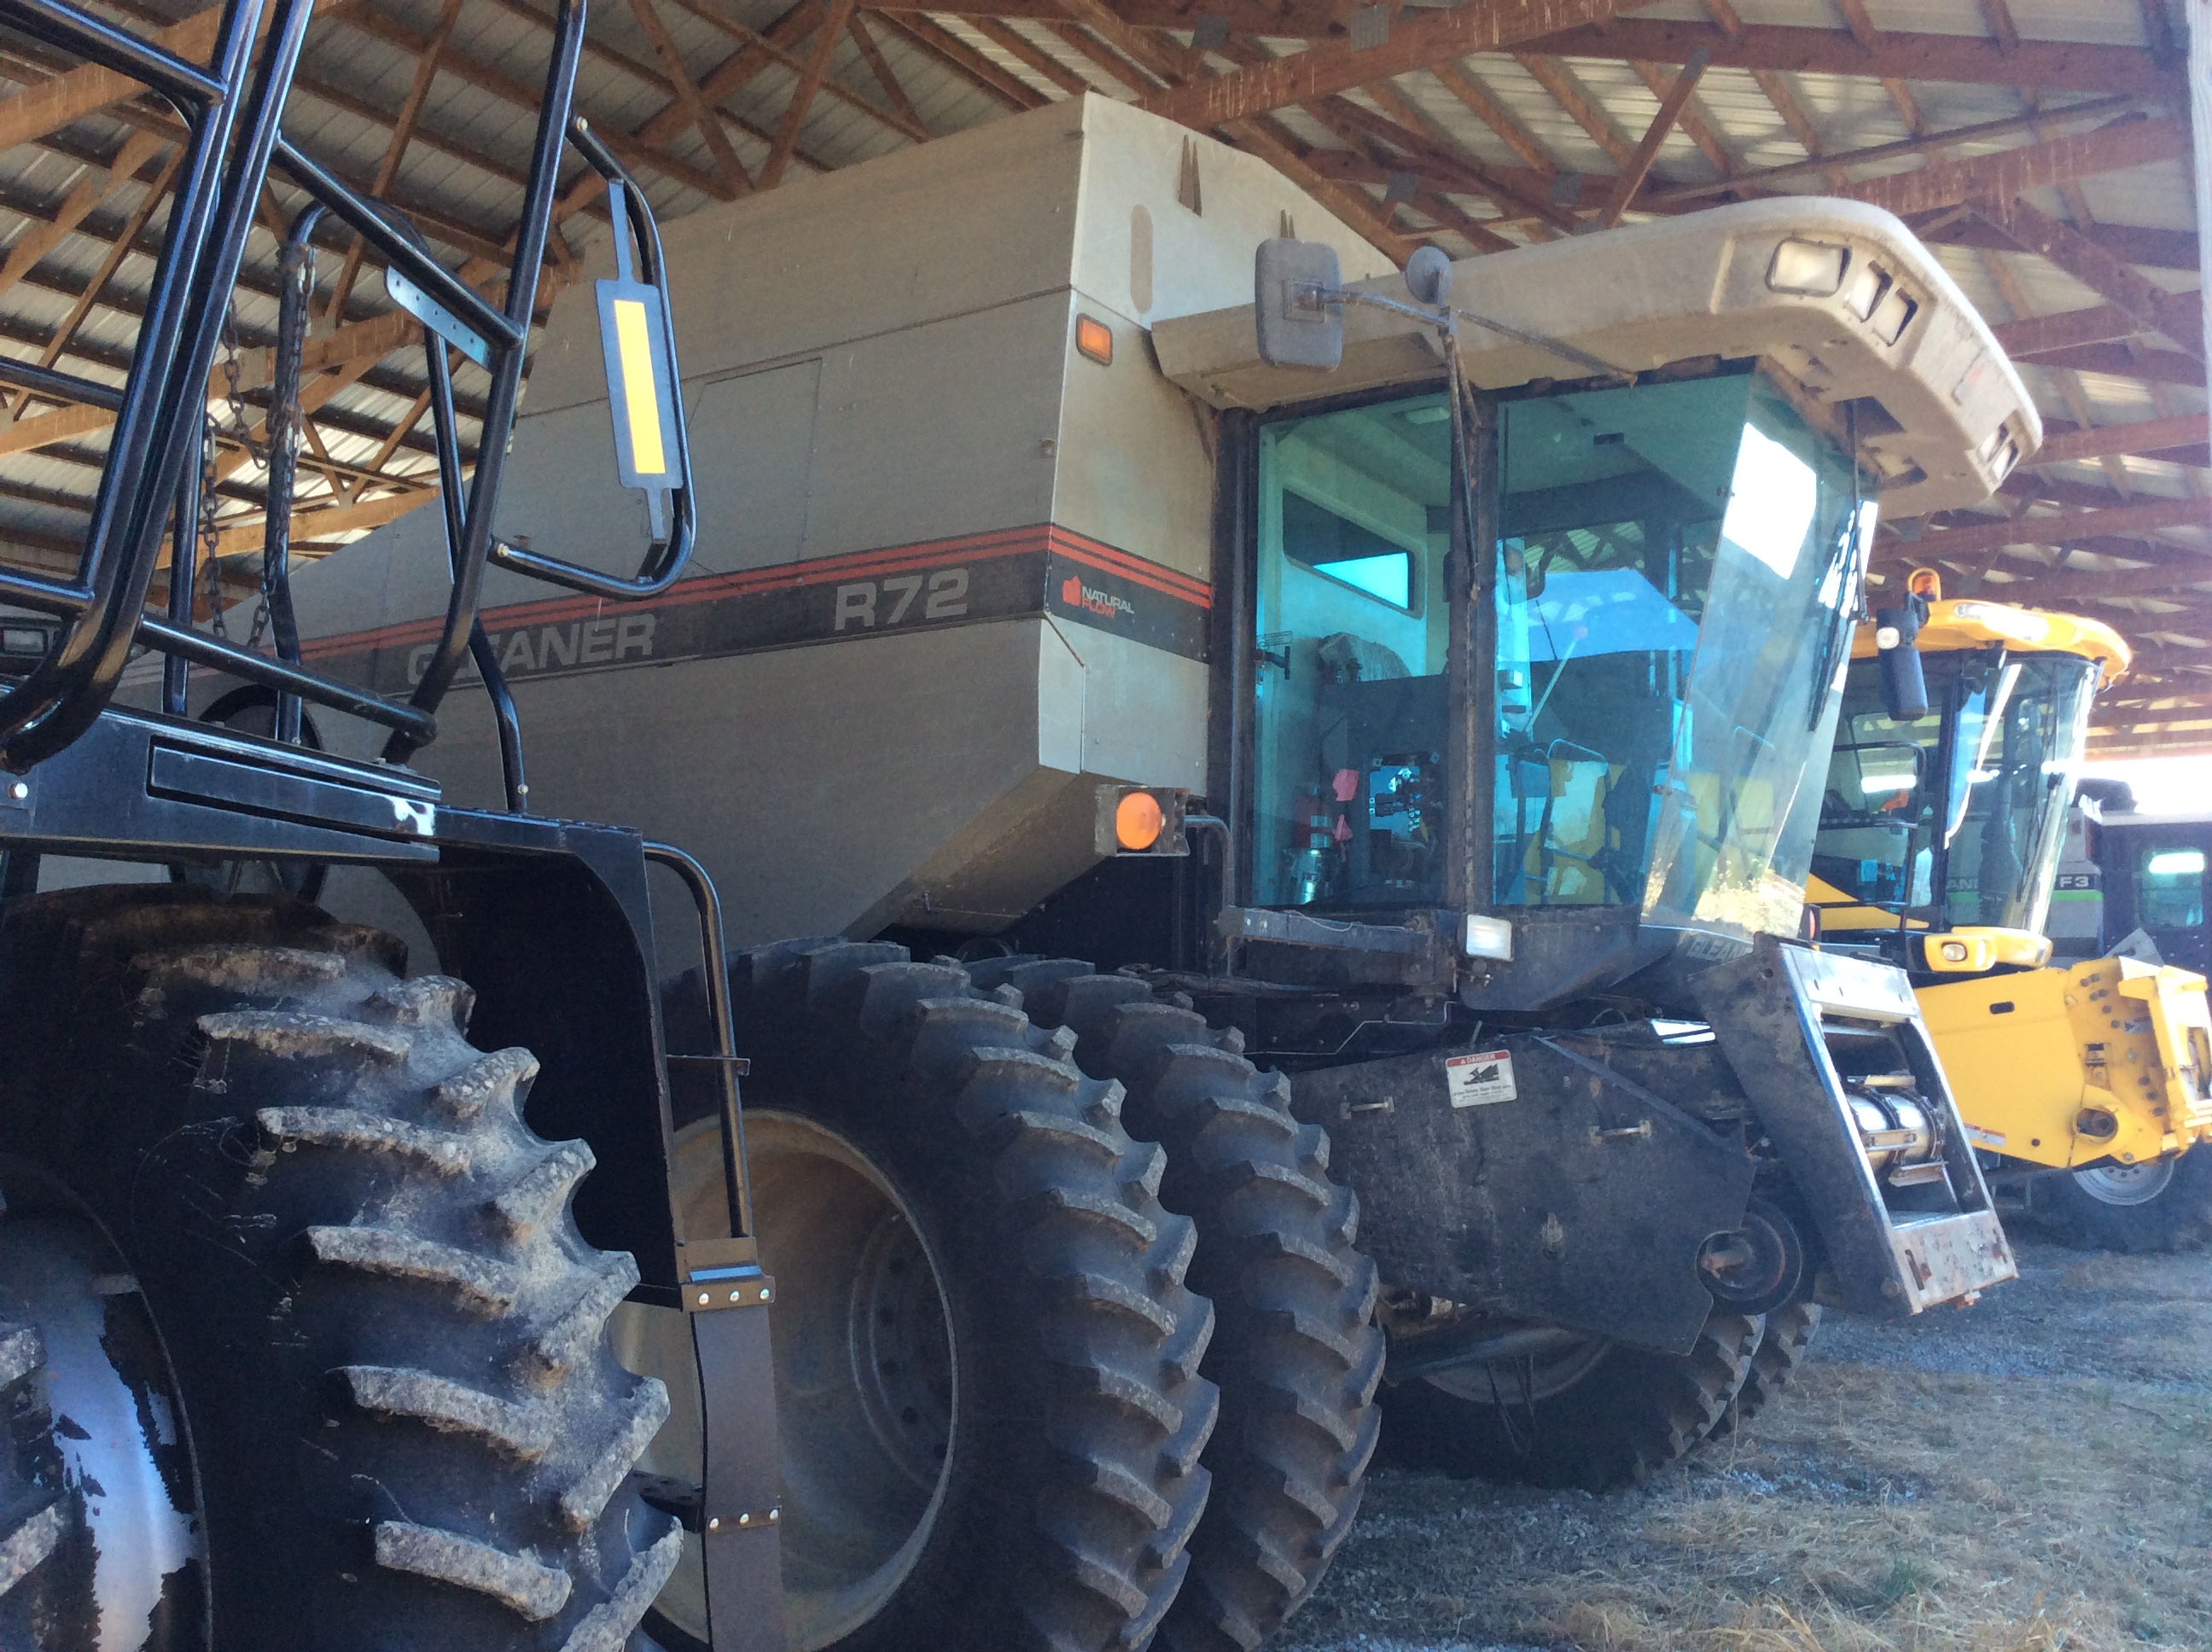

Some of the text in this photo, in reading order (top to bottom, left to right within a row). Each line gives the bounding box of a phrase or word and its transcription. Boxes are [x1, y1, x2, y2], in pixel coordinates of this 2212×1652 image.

[835, 567, 969, 631] R72
[1082, 586, 1135, 614] NATURAL
[1082, 597, 1116, 618] FLOW
[407, 613, 656, 684] GANER
[2059, 875, 2089, 887] F3
[1686, 935, 1755, 963] GLEAN
[1467, 1053, 1496, 1064] DANGER
